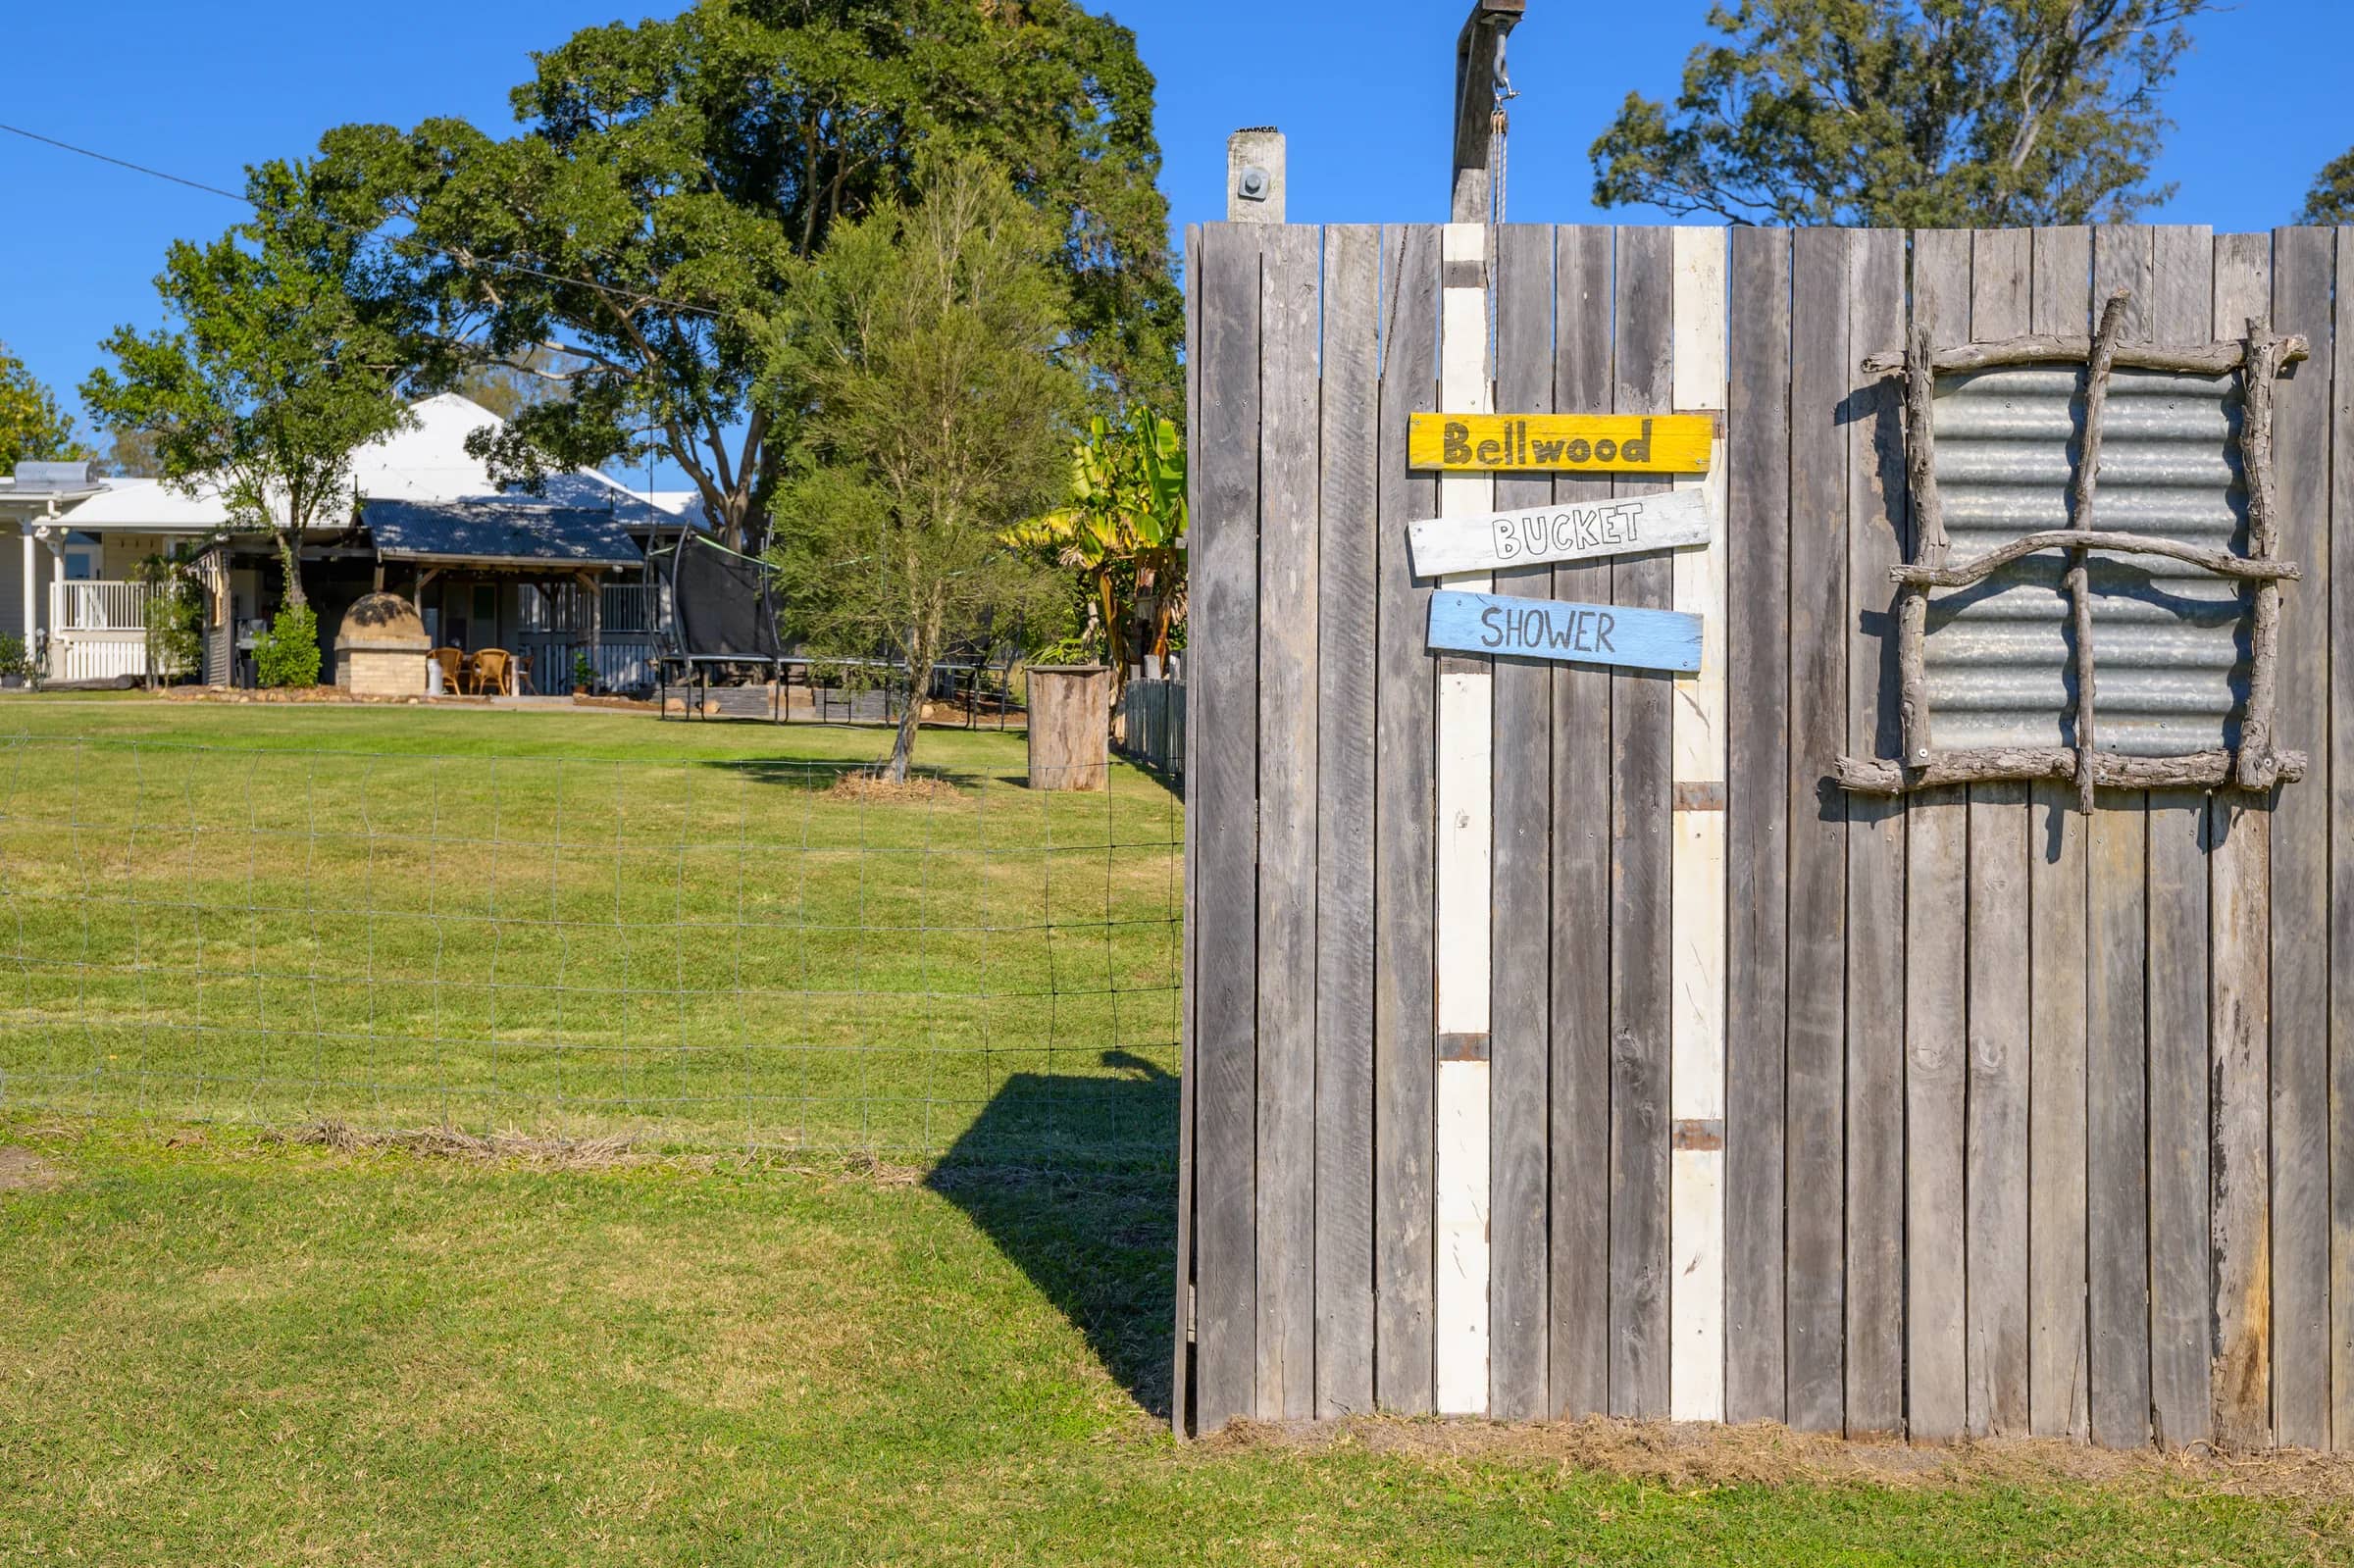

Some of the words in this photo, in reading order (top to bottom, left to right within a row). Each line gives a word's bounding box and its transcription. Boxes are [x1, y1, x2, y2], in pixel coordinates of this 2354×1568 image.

[1443, 419, 1653, 465] Bellwood
[1492, 502, 1643, 559] BUCKET
[1481, 606, 1615, 653] SHOWER
